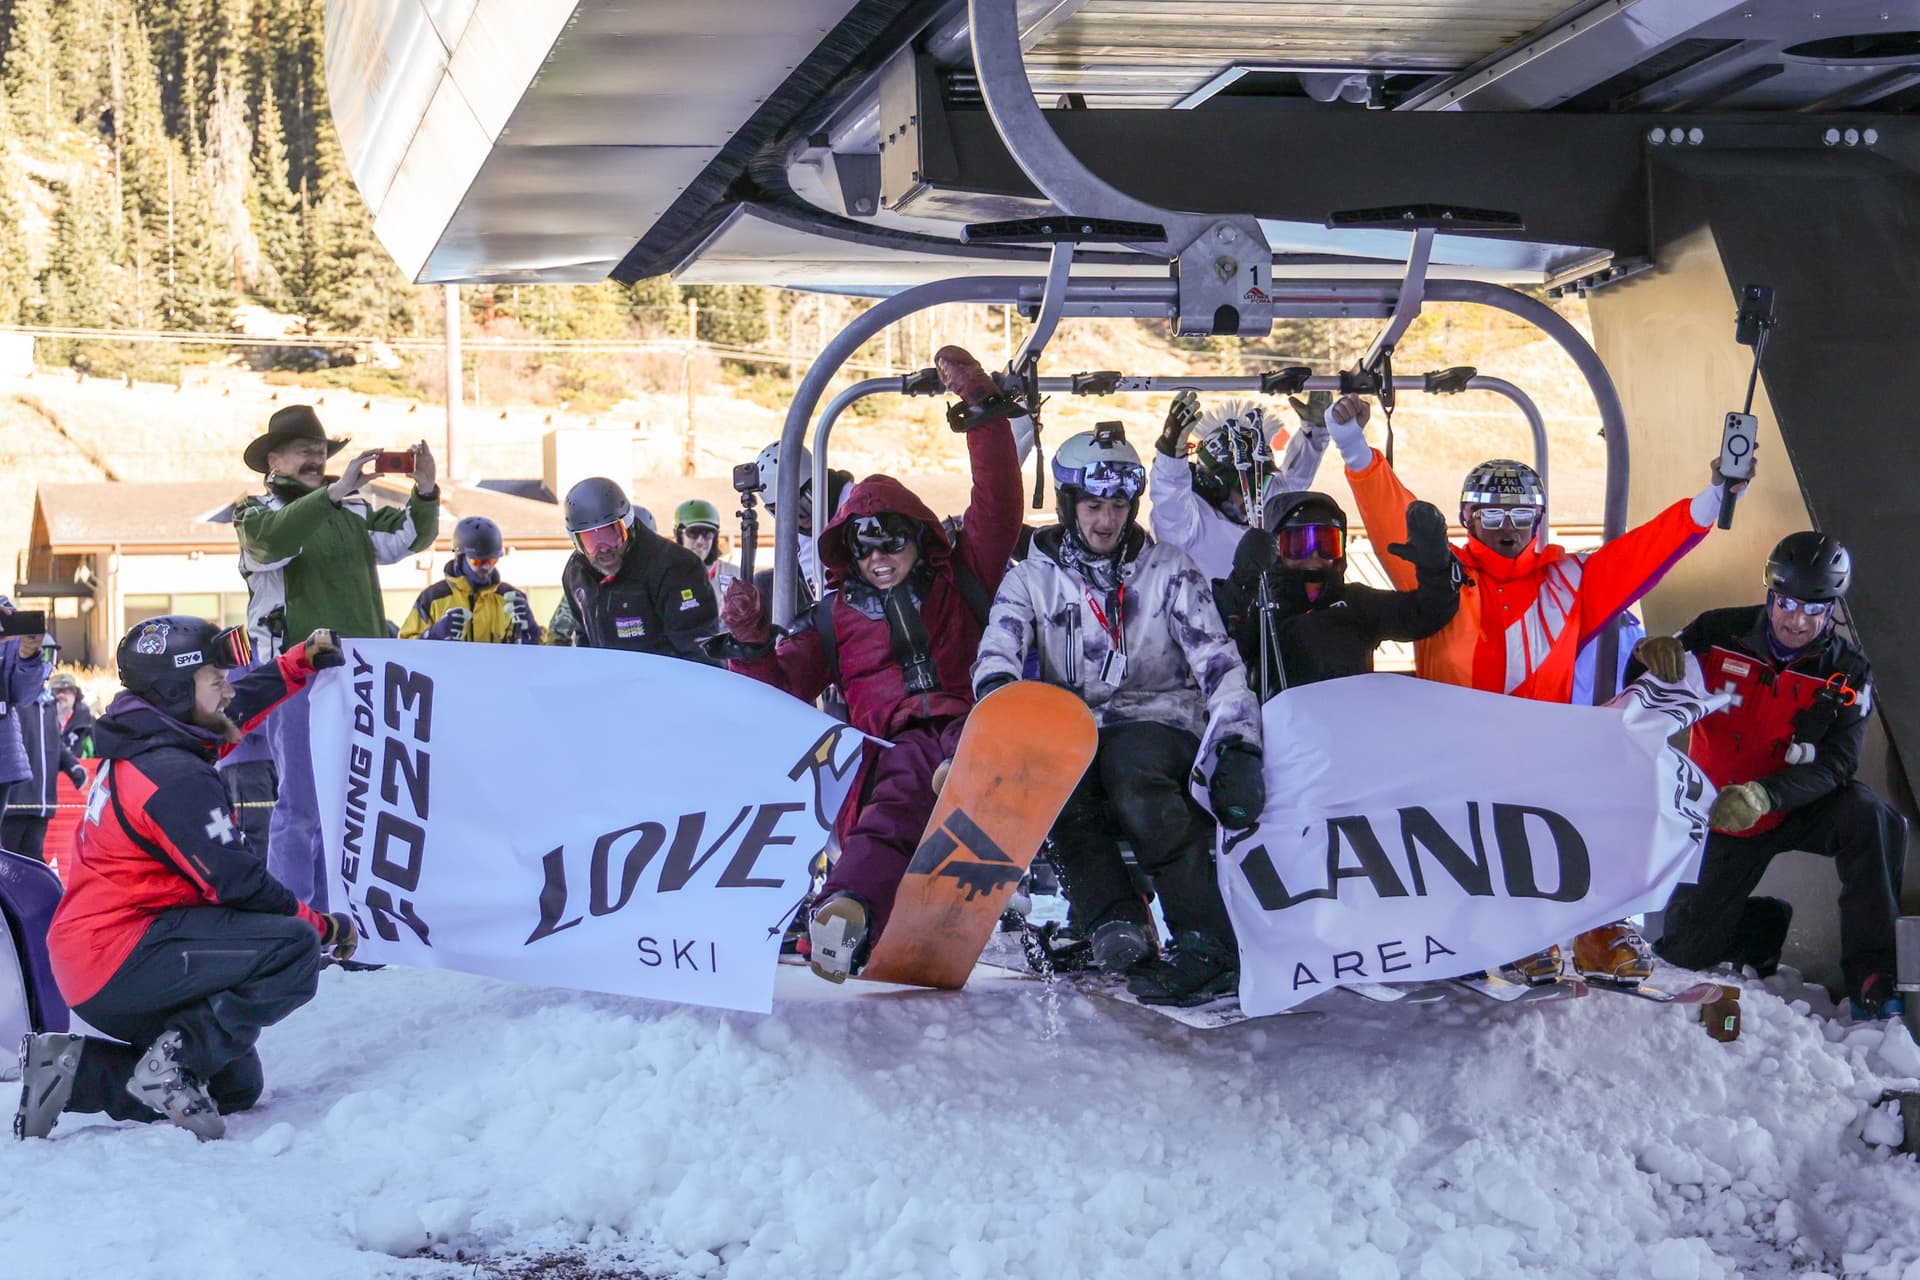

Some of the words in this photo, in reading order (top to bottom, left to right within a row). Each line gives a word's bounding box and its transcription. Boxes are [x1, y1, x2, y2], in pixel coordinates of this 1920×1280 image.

[1250, 265, 1258, 286] 1
[1497, 485, 1525, 494] LAND
[176, 655, 193, 665] SPY
[353, 647, 374, 737] DAY
[365, 661, 434, 947] 2023
[524, 802, 806, 945] LOVE
[1240, 801, 1591, 911] LAND
[637, 937, 717, 973] SKI
[1293, 935, 1456, 991] AREA
